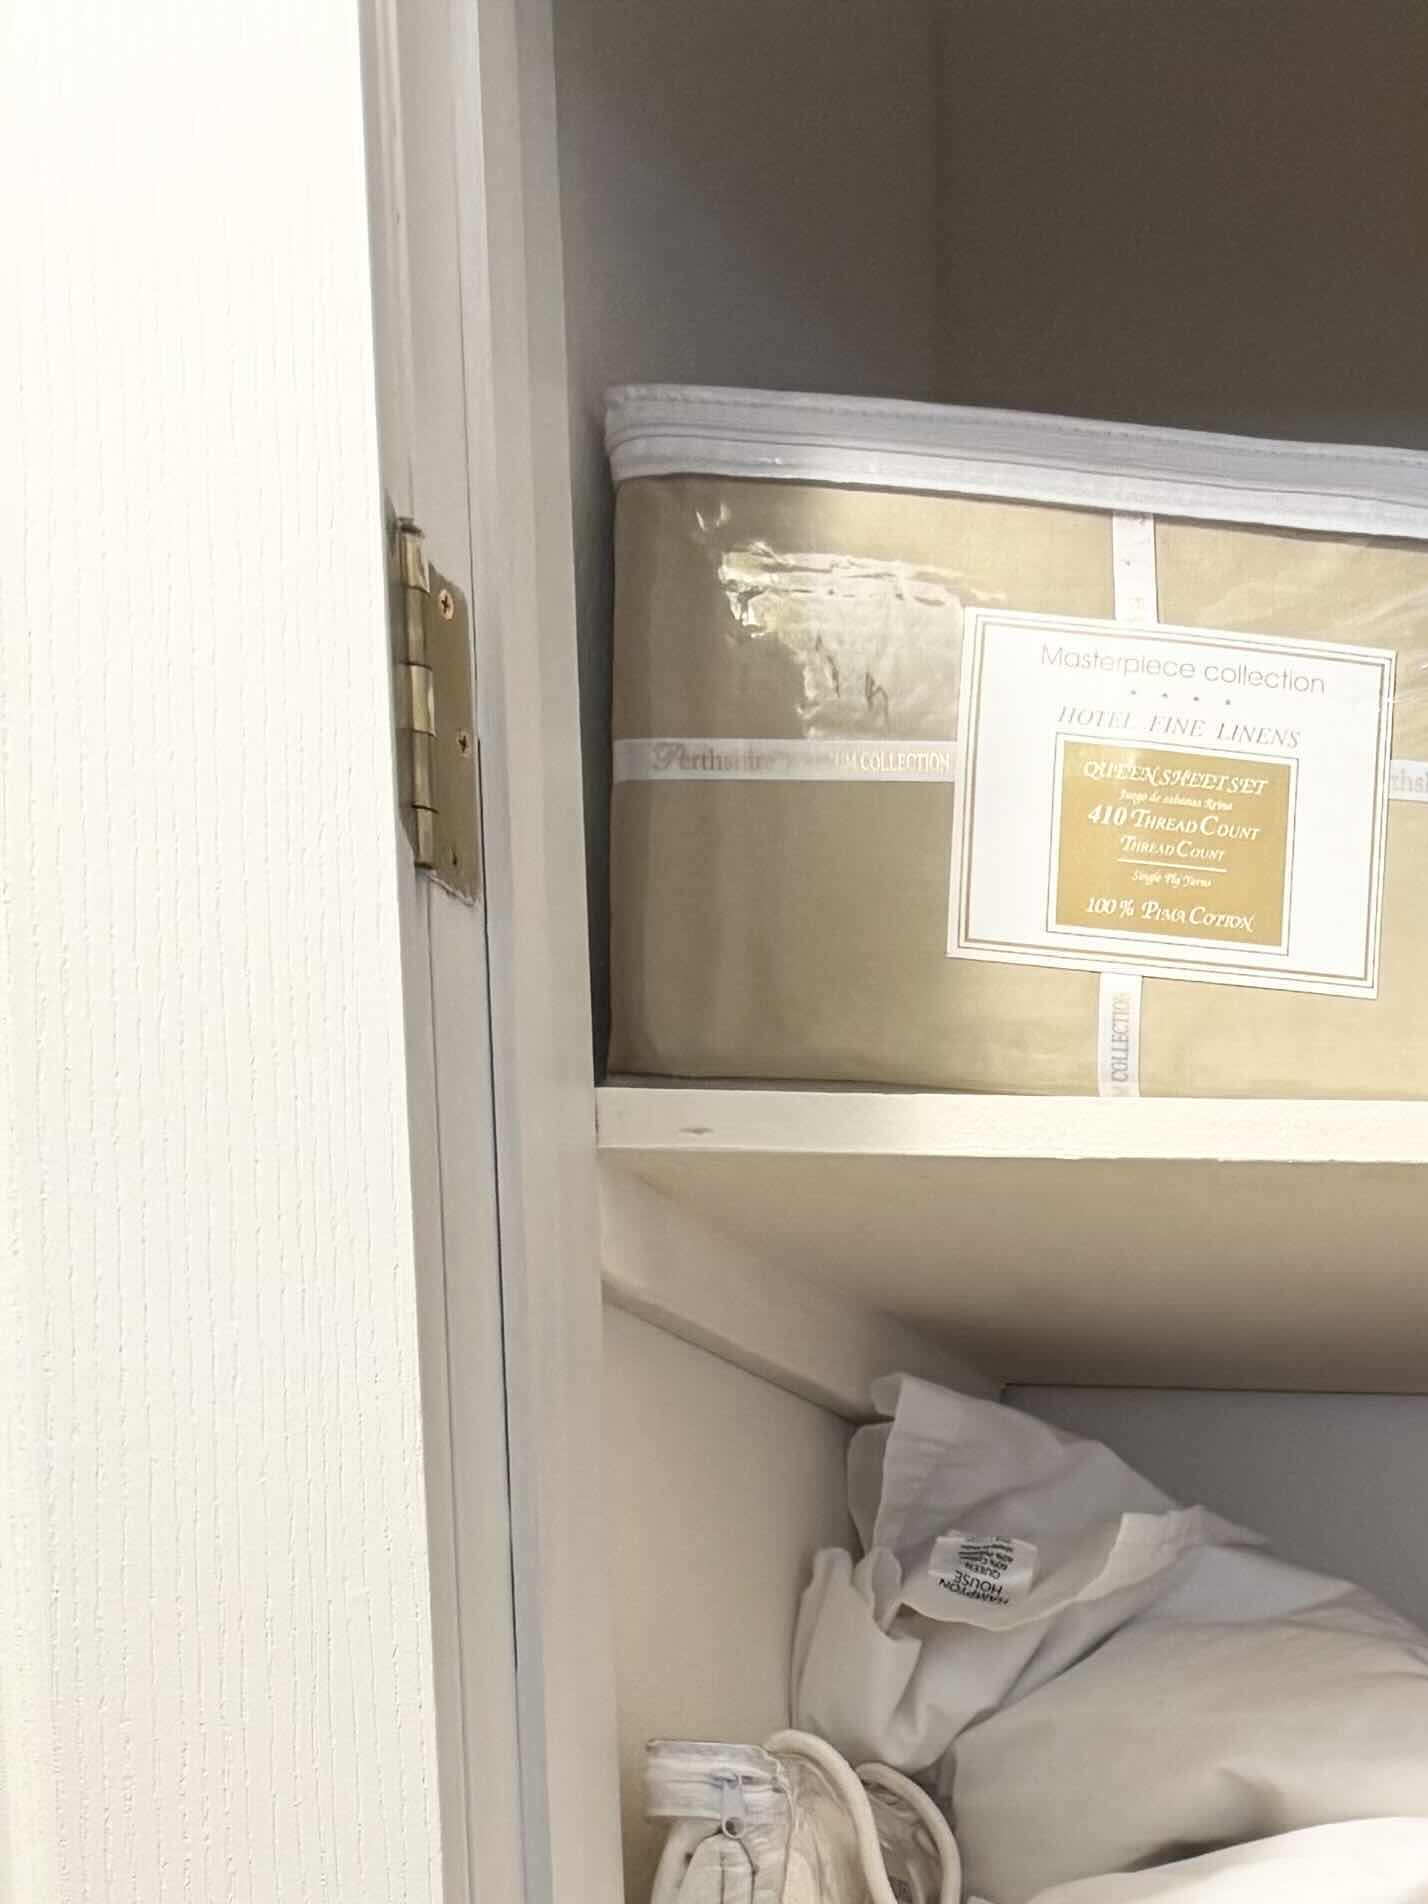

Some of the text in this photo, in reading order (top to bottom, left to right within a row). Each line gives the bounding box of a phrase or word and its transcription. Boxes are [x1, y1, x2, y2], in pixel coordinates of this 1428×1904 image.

[1041, 645, 1326, 694] Masterpiece collection
[1056, 705, 1301, 749] HOTEL FINE LINENS
[859, 751, 950, 772] COLLECTION
[1087, 805, 1127, 827] 410
[953, 1570, 1003, 1594] HOUSE
